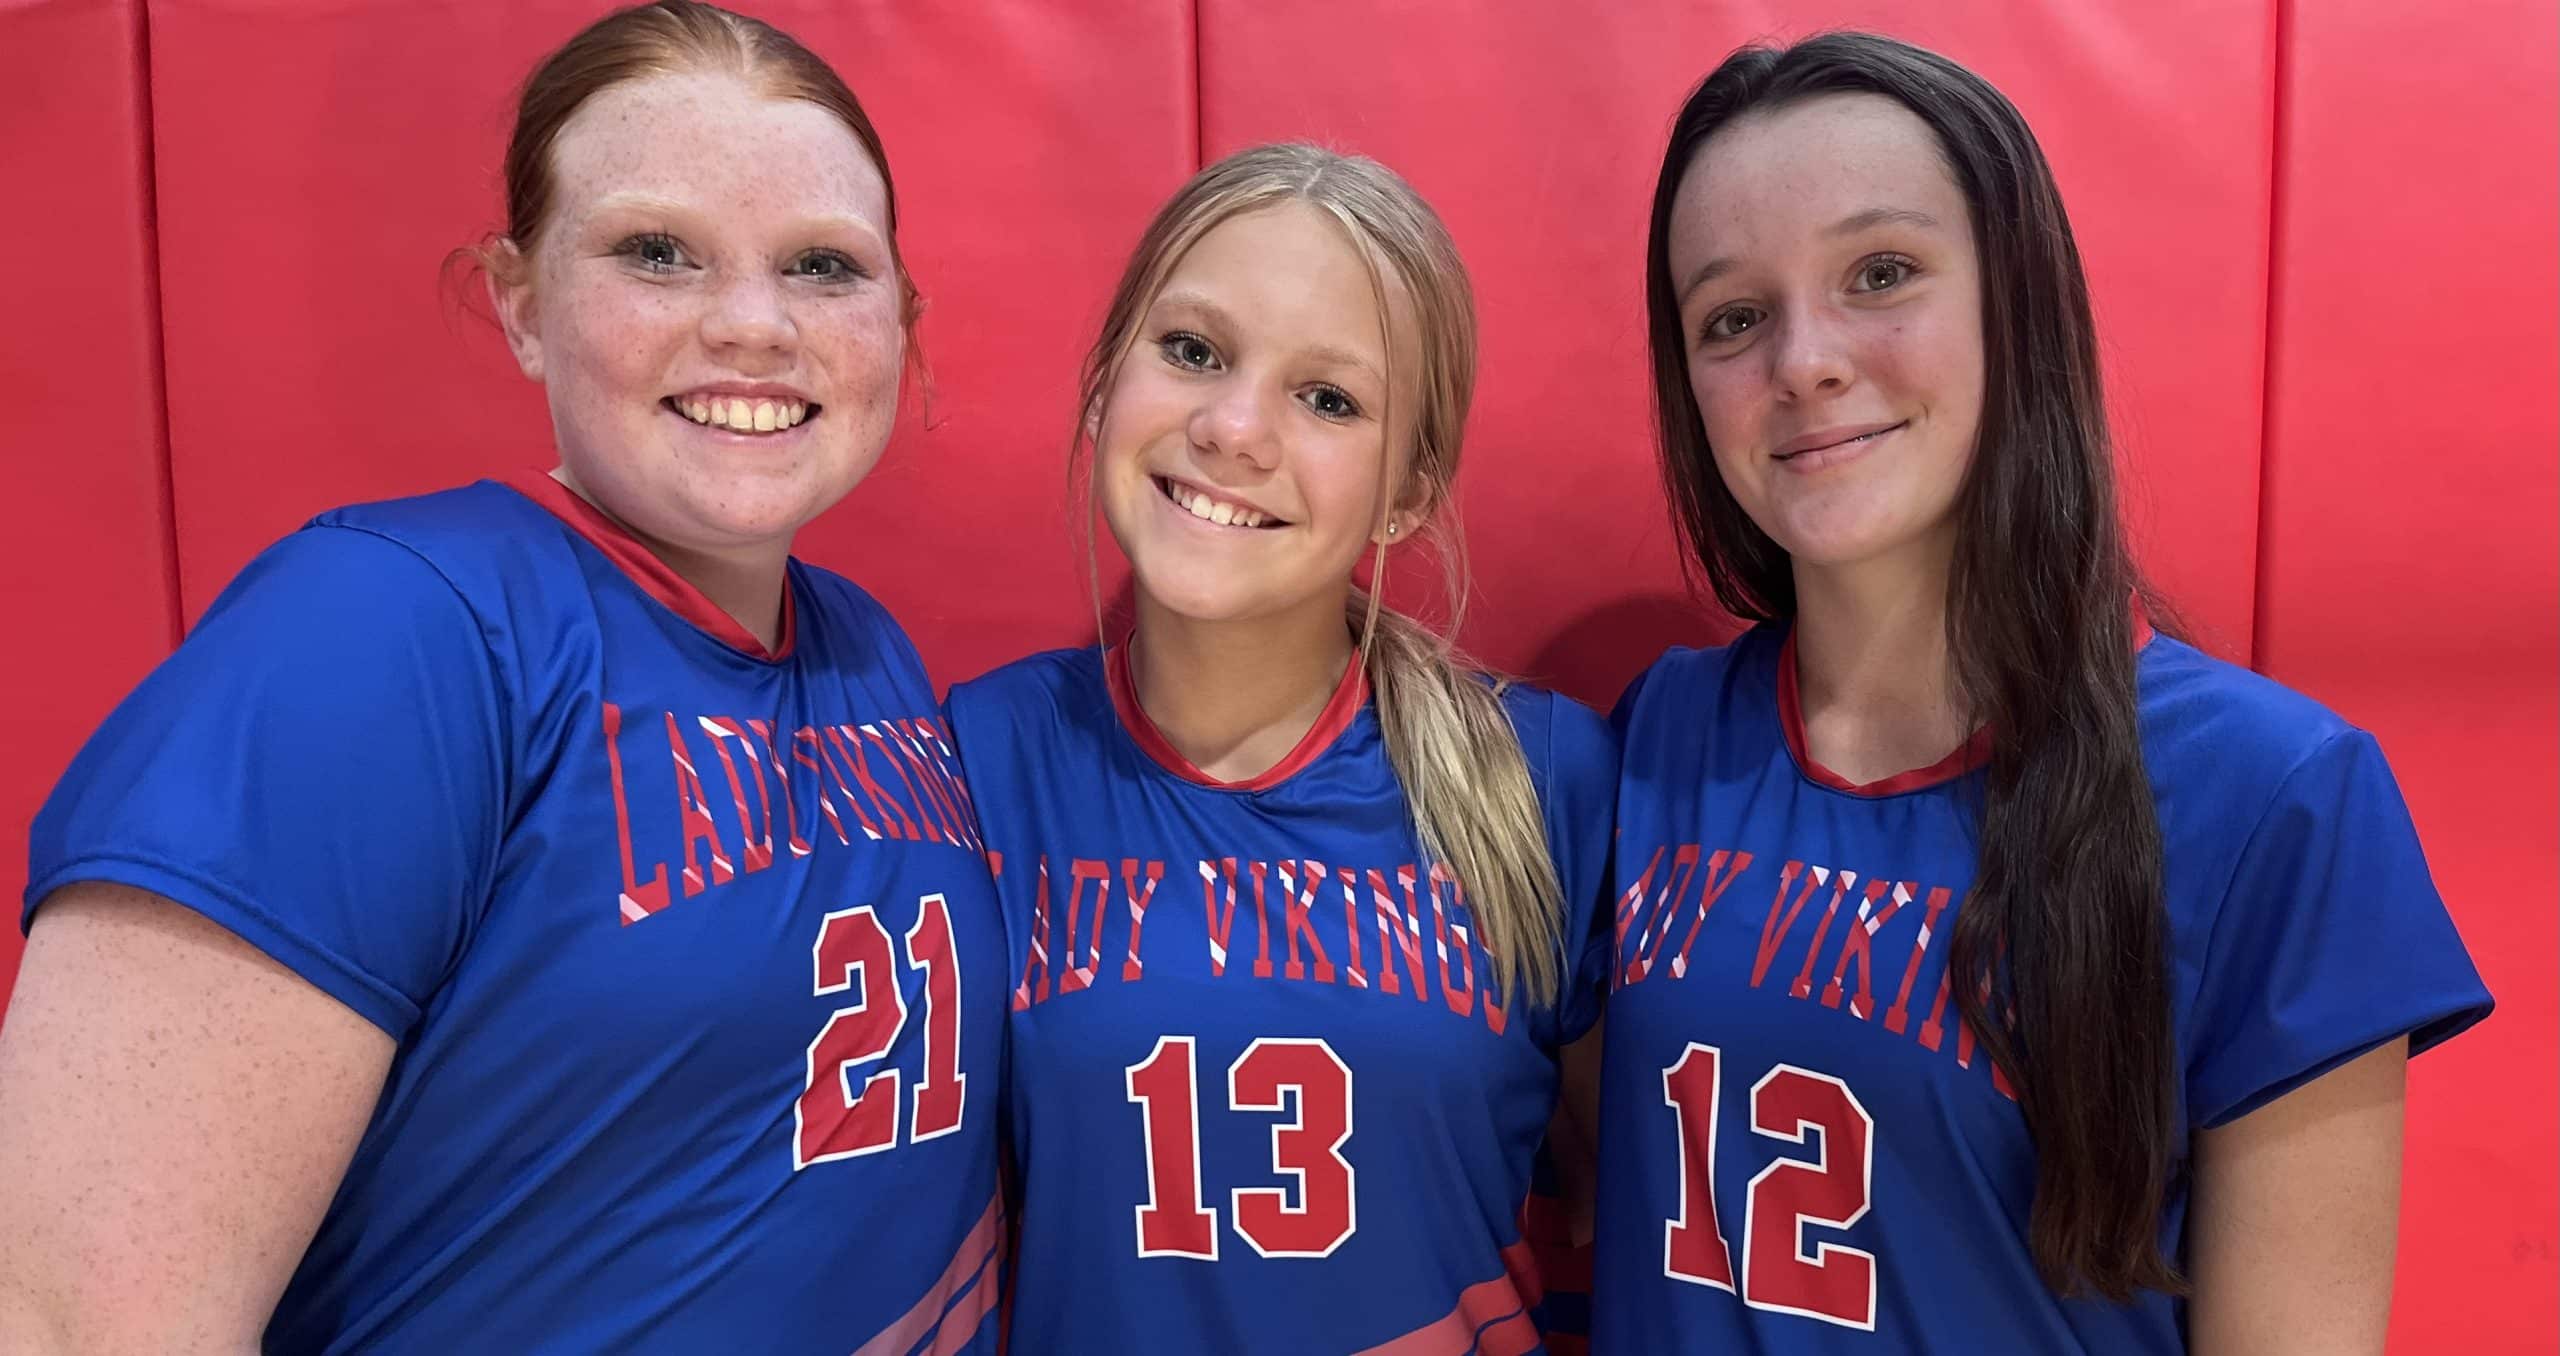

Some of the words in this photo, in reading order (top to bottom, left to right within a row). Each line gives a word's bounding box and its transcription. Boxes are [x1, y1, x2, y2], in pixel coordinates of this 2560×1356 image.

[602, 701, 812, 927] LADY
[792, 715, 990, 866] VIKING
[986, 850, 1164, 1012] ADY
[793, 893, 967, 1172] 21
[1611, 828, 1755, 995] ADY
[1749, 859, 2019, 1103] VIKI
[1125, 1035, 1357, 1262] 13
[1662, 1041, 1877, 1332] 12
